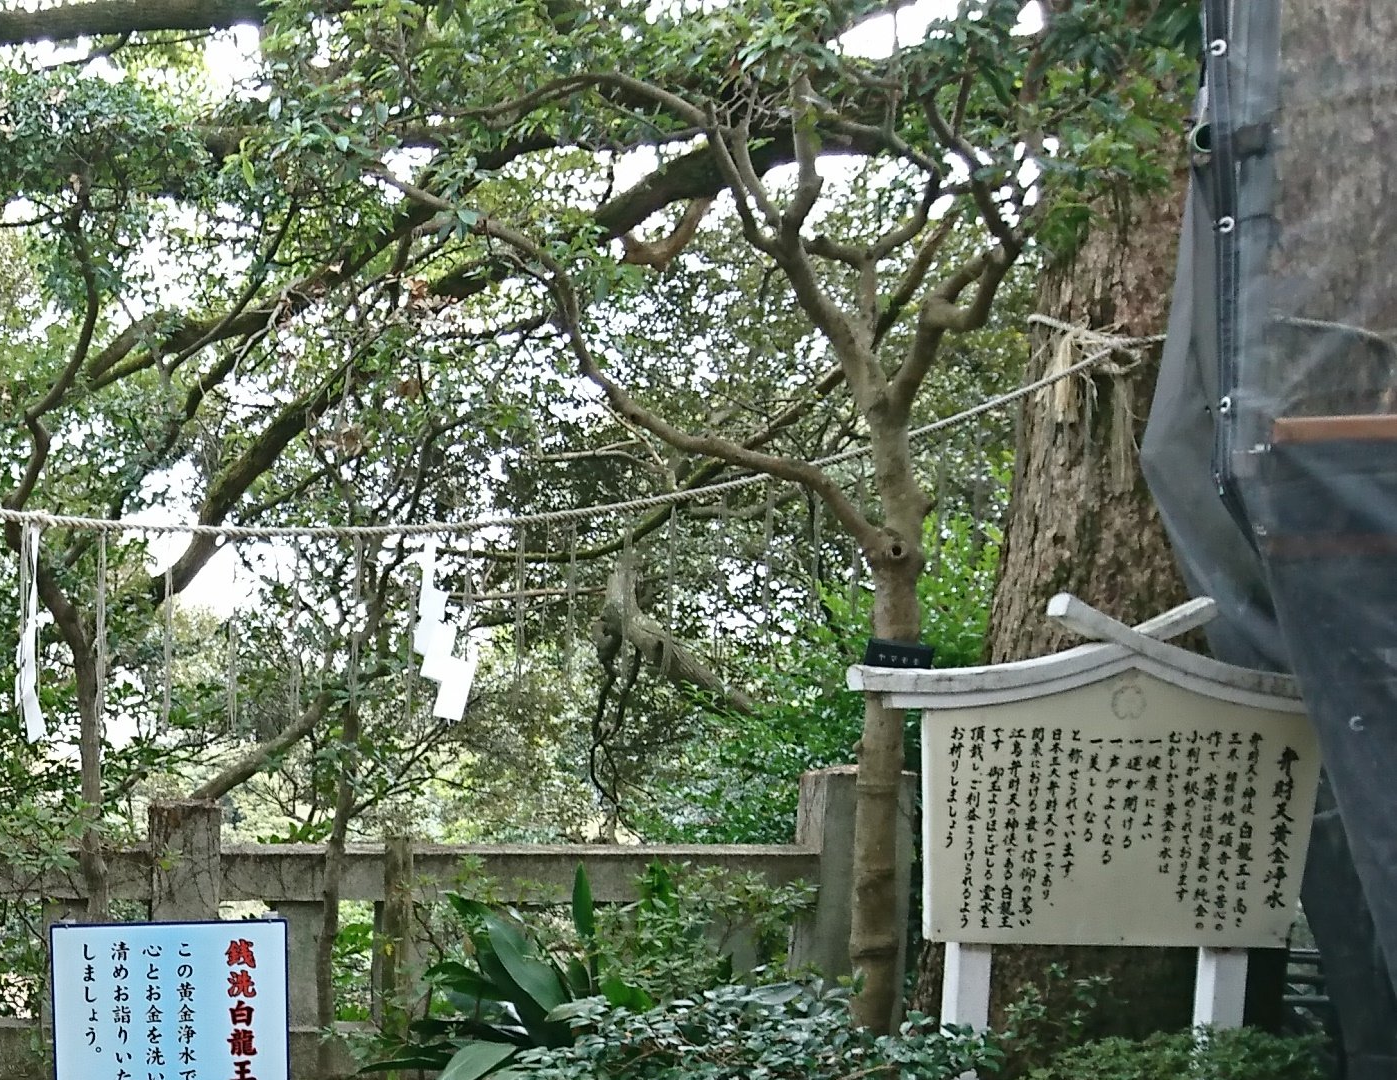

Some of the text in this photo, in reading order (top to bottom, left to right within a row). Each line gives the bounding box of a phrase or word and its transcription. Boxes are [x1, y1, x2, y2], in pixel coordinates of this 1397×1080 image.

[945, 725, 965, 849] お祈りしましょう
[1264, 746, 1299, 909] 弁財天黄金浄水
[82, 943, 102, 1054] しましょう。
